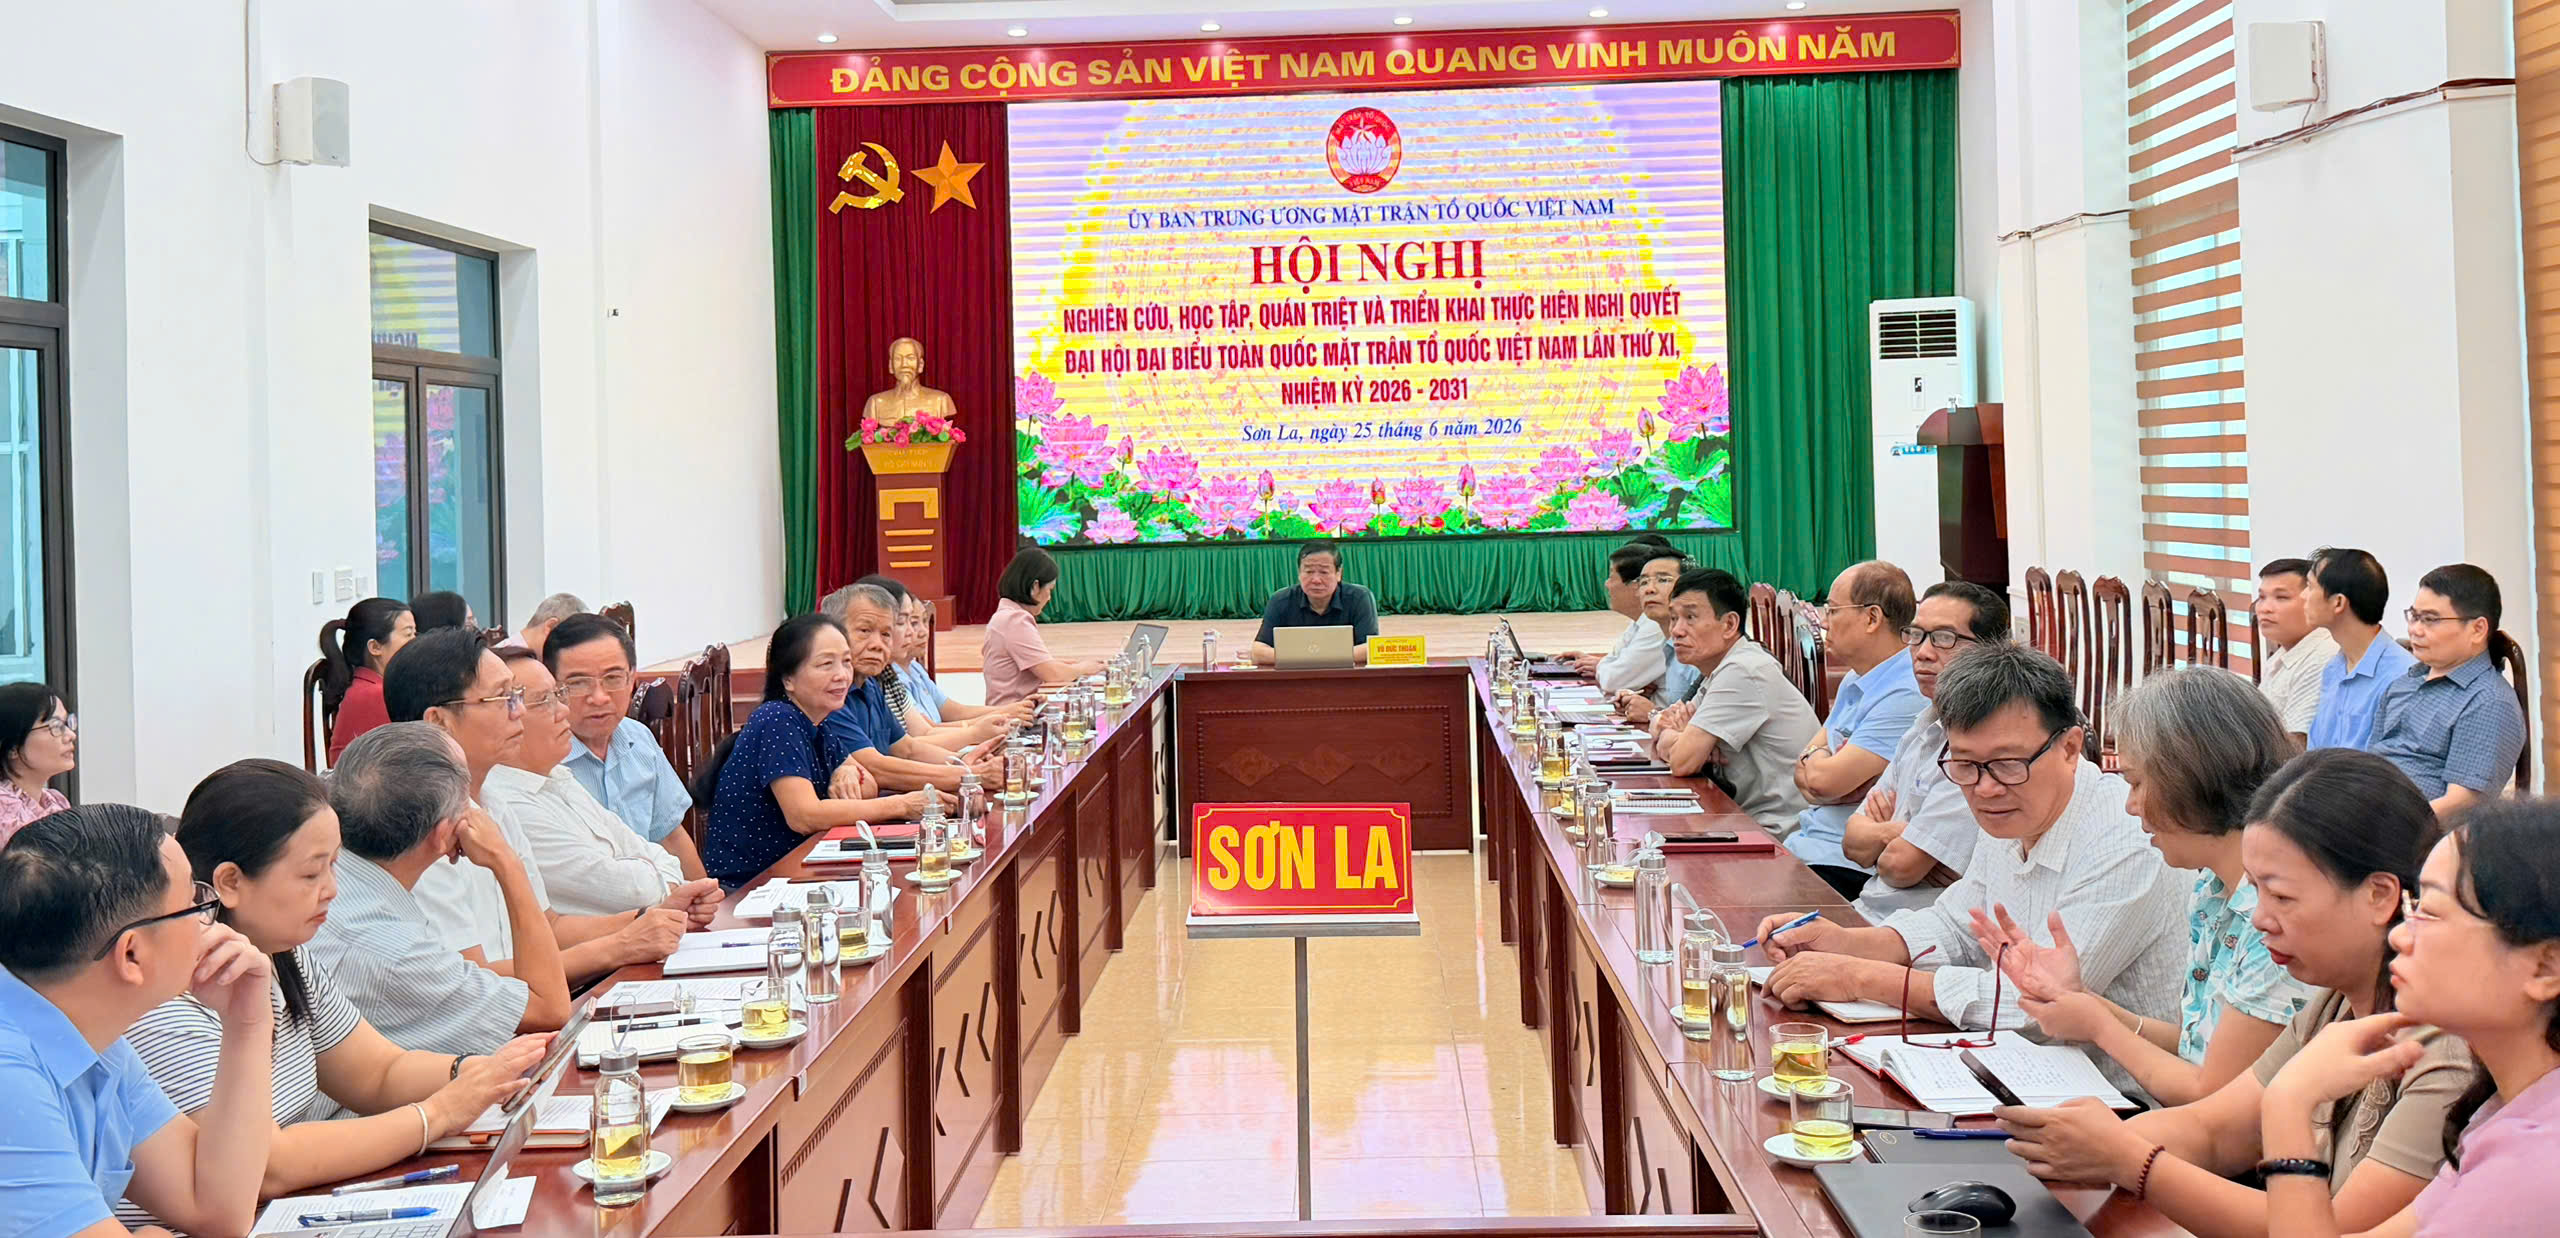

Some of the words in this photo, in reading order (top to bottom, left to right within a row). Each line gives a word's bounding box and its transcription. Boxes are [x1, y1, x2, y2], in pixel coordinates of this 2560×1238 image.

[831, 57, 950, 93] ĐẢNG
[960, 56, 1078, 96] CỘNG
[1087, 49, 1172, 85] SẢN
[1180, 48, 1270, 88] VIỆT
[1280, 50, 1376, 78] NAM
[1385, 43, 1537, 75] QUANG
[1548, 41, 1647, 68] VINH
[1658, 31, 1787, 64] MUÔN
[1798, 26, 1896, 60] NĂM
[1128, 209, 1153, 229] ỦY
[1160, 211, 1196, 228] BAN
[1201, 209, 1265, 226] TRUNG
[1271, 206, 1326, 225] ƯƠNG
[1332, 205, 1373, 226] MẶT
[1379, 203, 1429, 224] TRẬN
[1435, 199, 1460, 219] TỔ
[1466, 198, 1520, 221] QUỐC
[1526, 198, 1566, 219] VIỆT
[1572, 199, 1614, 215] NAM
[1250, 236, 1342, 294] HỘI
[1357, 239, 1487, 289] NGHỊ
[1063, 303, 1127, 333] NGHIÊN
[1134, 302, 1173, 332] CỨU,
[1180, 305, 1213, 334] HỌC
[1219, 300, 1253, 333] TẬP,
[1259, 298, 1306, 329] QUÁN
[1312, 296, 1358, 330] TRIỆT
[1363, 296, 1385, 324] VÀ
[1391, 289, 1439, 323] TRIỂN
[1446, 297, 1485, 322] KHAI
[1491, 292, 1535, 325] THỰC
[1541, 290, 1578, 324] HIỆN
[1585, 293, 1624, 322] NGHỊ
[1630, 284, 1680, 317] QUYẾT
[1065, 350, 1094, 379] ĐẠI
[1101, 344, 1130, 377] HỘI
[1137, 347, 1165, 376] ĐẠI
[1172, 337, 1212, 370] BIỂU
[1218, 339, 1263, 368] TOÀN
[1270, 336, 1317, 368] QUỐC
[1323, 337, 1360, 372] MẶT
[1367, 336, 1411, 370] TRẬN
[1417, 330, 1437, 363] TỔ
[1444, 330, 1491, 365] QUỐC
[1496, 332, 1532, 366] VIỆT
[1538, 335, 1577, 359] NAM
[1583, 327, 1615, 359] LẦN
[1620, 330, 1655, 358] THỨ
[1659, 332, 1680, 359] XI,
[1281, 376, 1337, 409] NHIỆM
[1343, 375, 1364, 403] KỲ
[1370, 379, 1412, 402] 2026
[1429, 378, 1468, 400] 2031
[1242, 425, 1272, 441] Sơn
[1277, 424, 1303, 442] La,
[1310, 423, 1348, 446] ngày
[1353, 423, 1373, 438] 25
[1378, 421, 1422, 440] tháng
[1429, 420, 1438, 436] 6
[1444, 420, 1478, 435] năm
[1484, 418, 1522, 434] 2026
[1207, 820, 1315, 891] SƠN
[1334, 825, 1399, 890] LA
